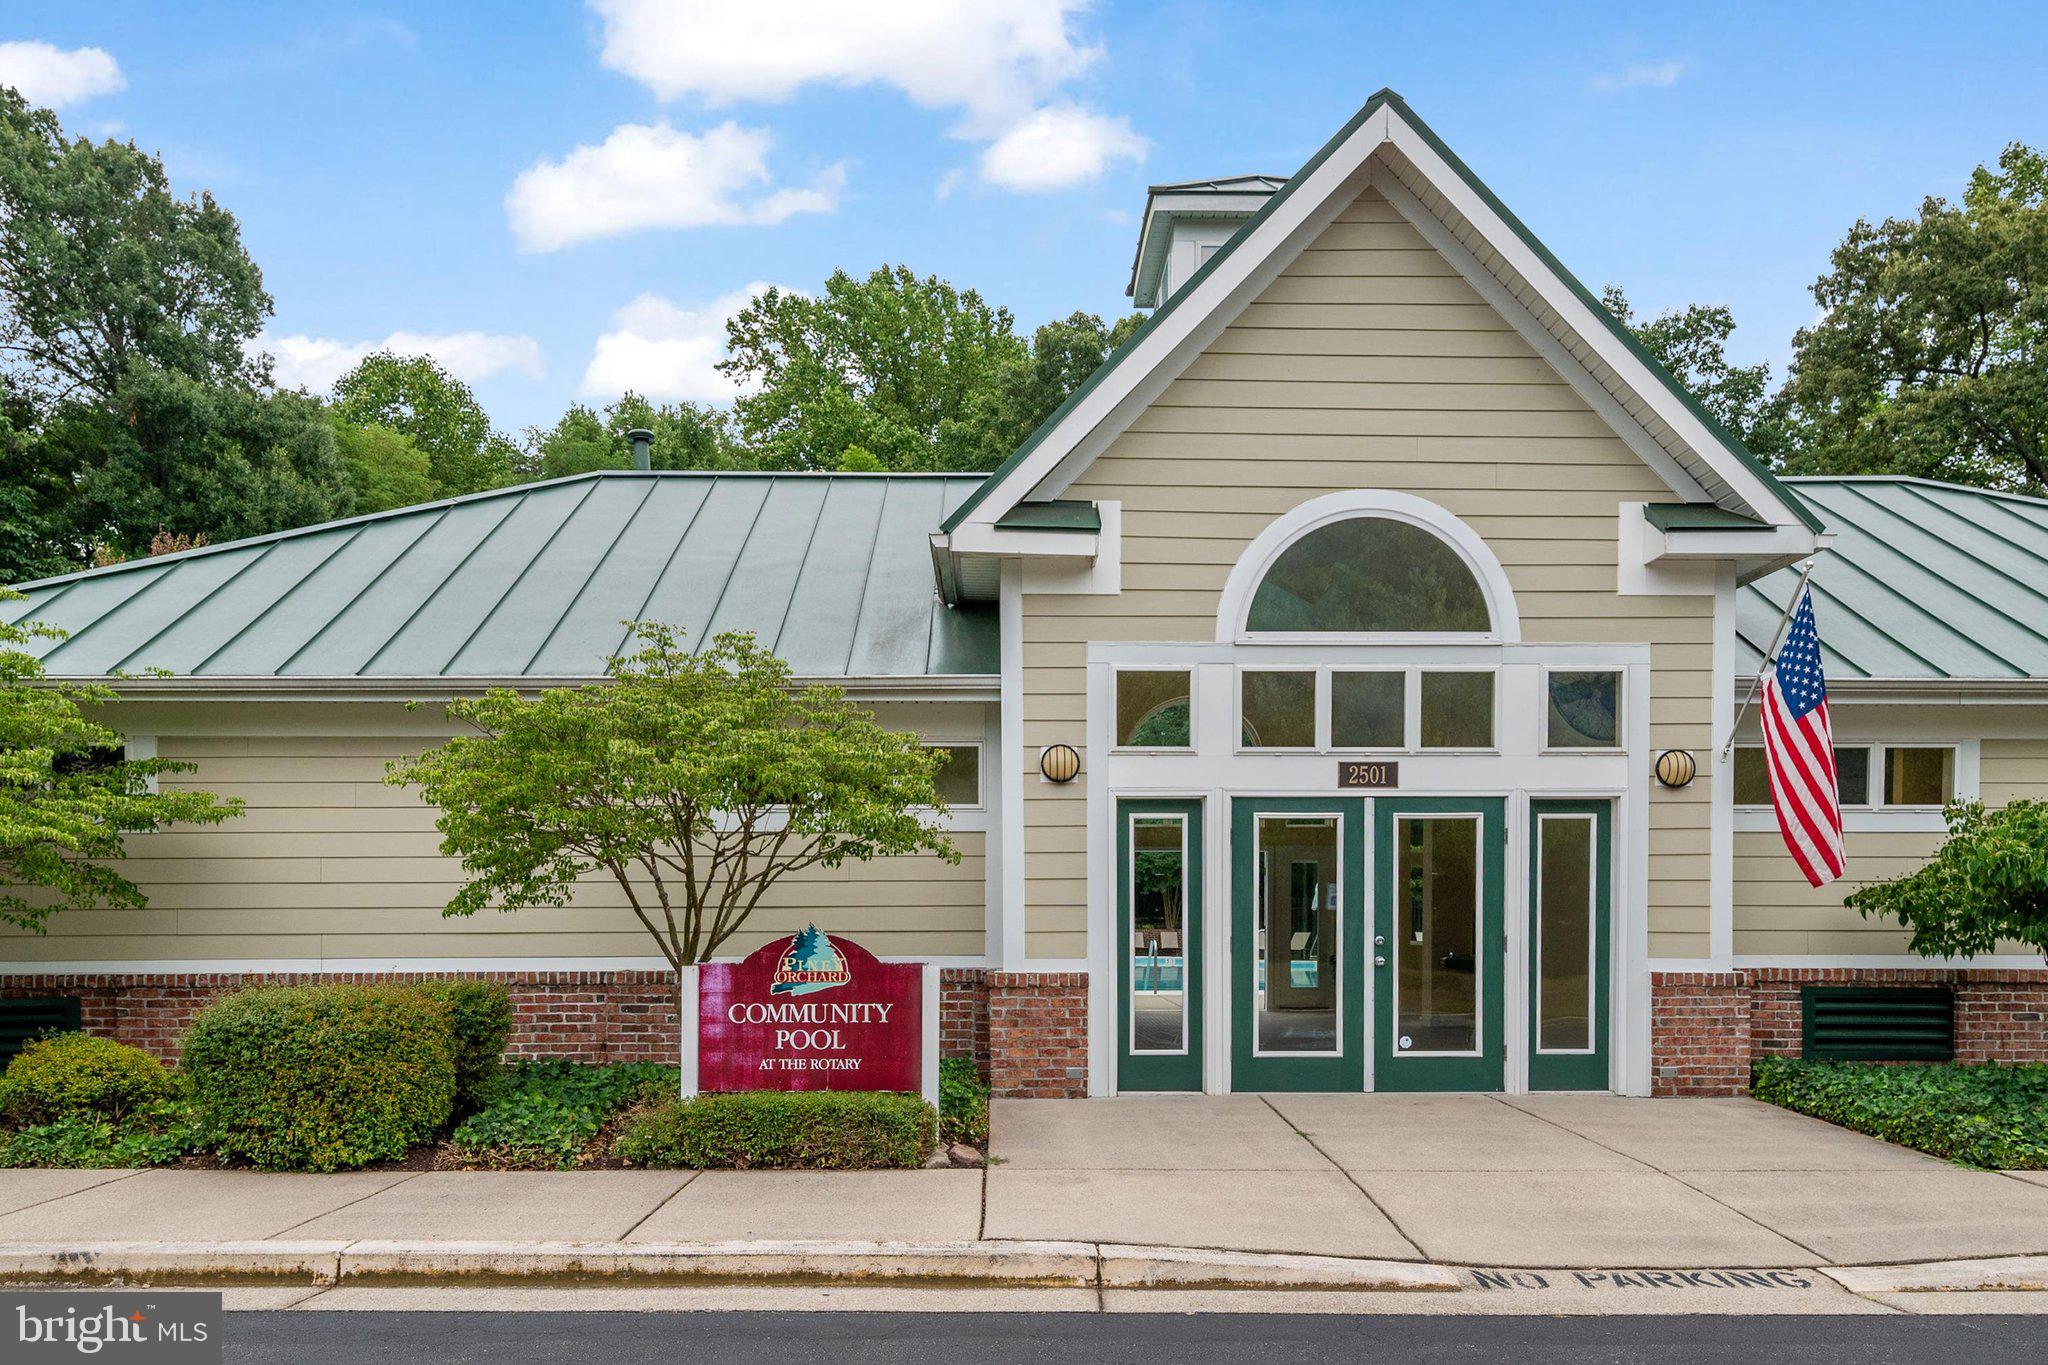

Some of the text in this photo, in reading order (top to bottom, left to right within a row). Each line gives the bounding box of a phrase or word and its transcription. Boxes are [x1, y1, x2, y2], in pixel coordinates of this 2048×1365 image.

[1348, 765, 1387, 784] 2501
[783, 957, 844, 971] PINEY
[777, 971, 848, 982] ORCHARD
[728, 1003, 893, 1024] COMMUNITY
[775, 1029, 846, 1050] POOL
[758, 1058, 862, 1070] AT THE ROTARY
[1469, 1267, 1812, 1290] NO PARKING
